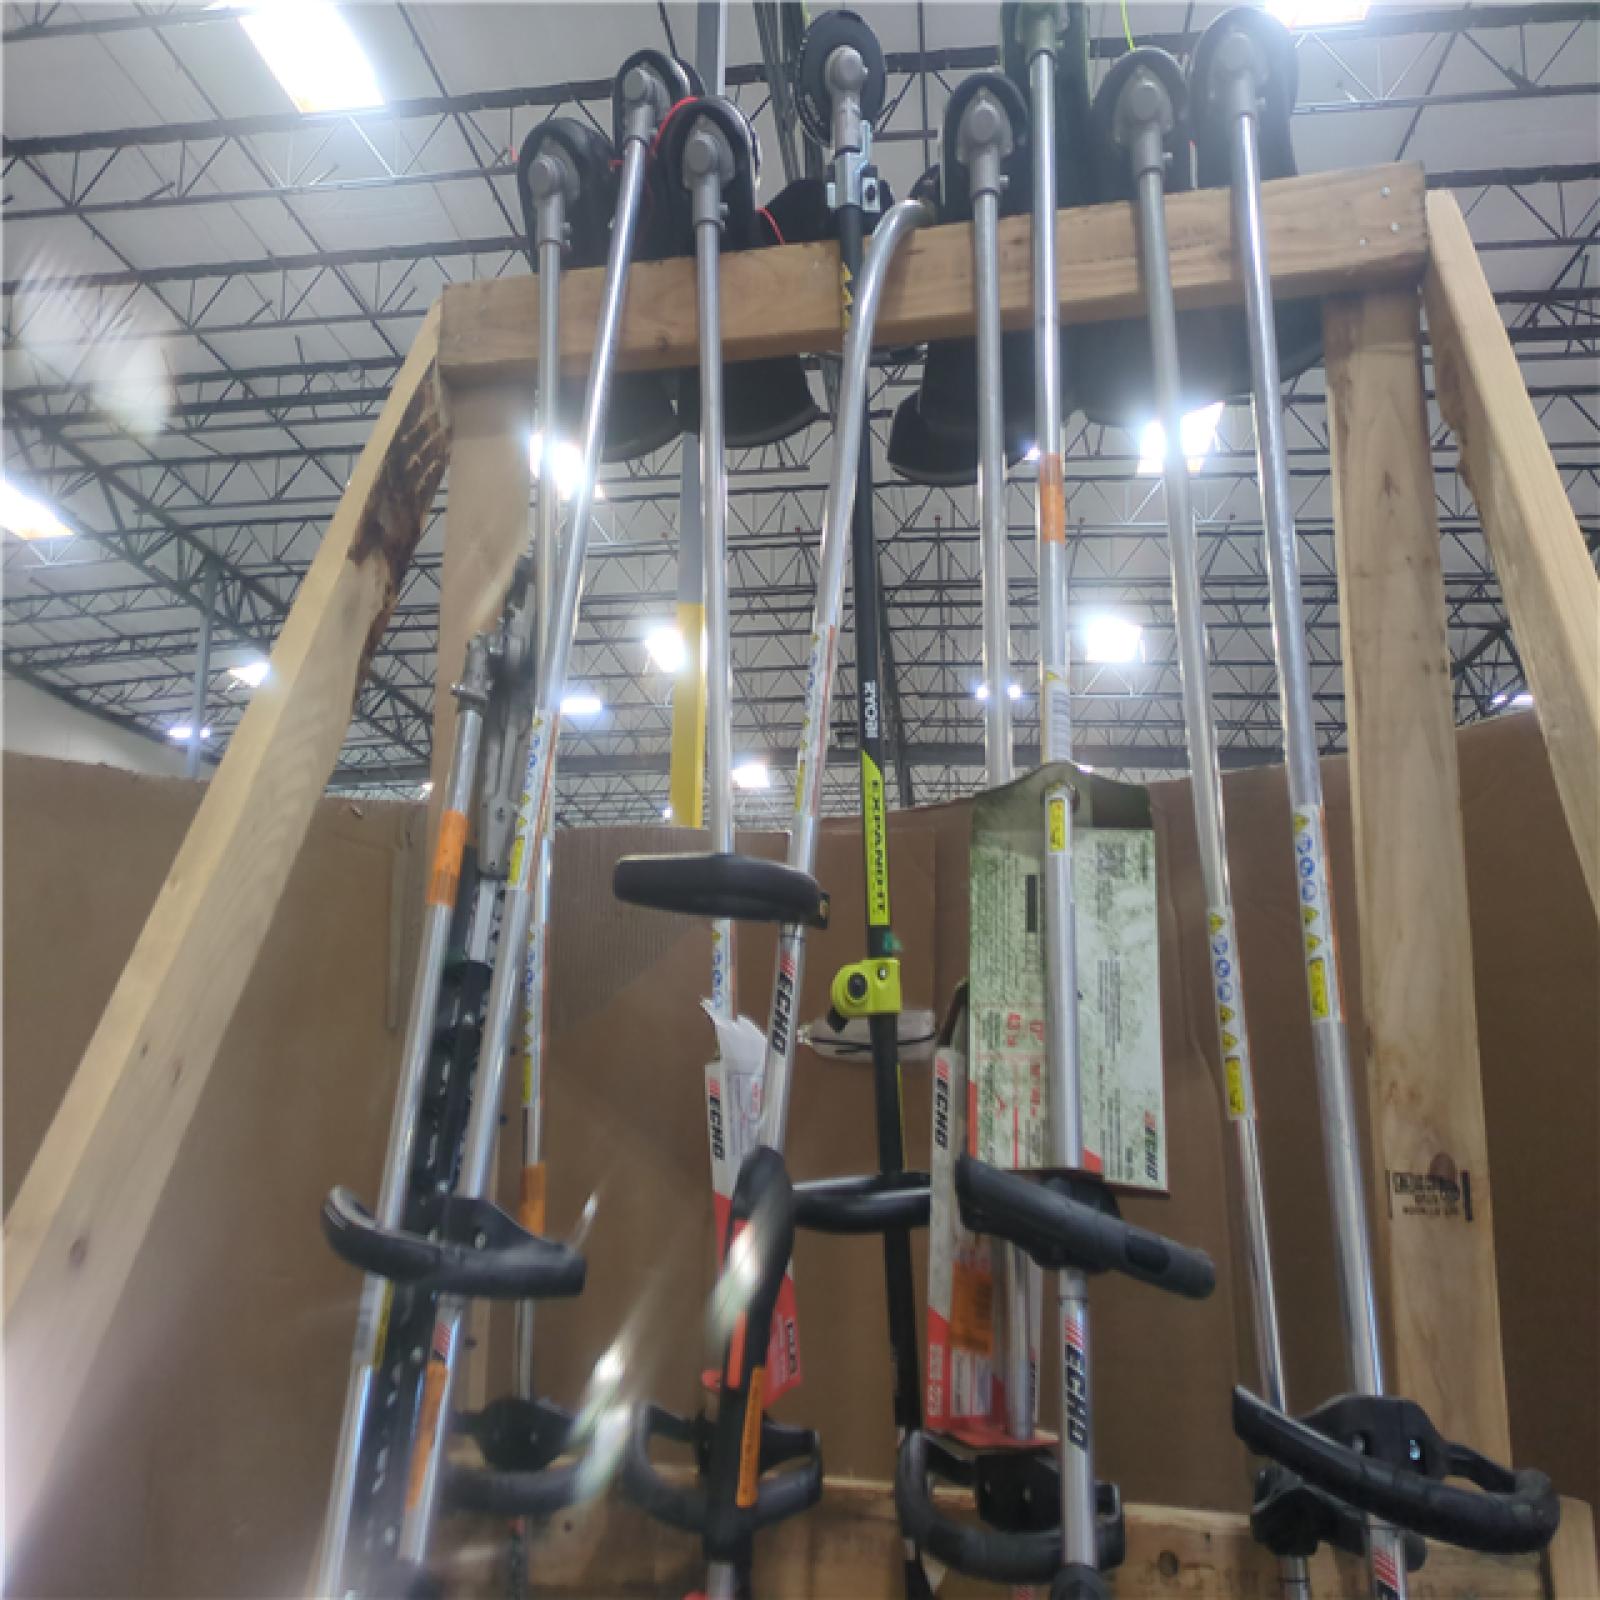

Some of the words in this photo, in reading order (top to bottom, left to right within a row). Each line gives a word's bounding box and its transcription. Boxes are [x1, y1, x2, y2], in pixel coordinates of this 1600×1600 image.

[864, 680, 878, 738] RYOBI
[773, 972, 793, 1056] ECHO
[710, 1095, 726, 1160] ECHO
[935, 1077, 949, 1150] ECHO
[1066, 1345, 1088, 1451] ECHO
